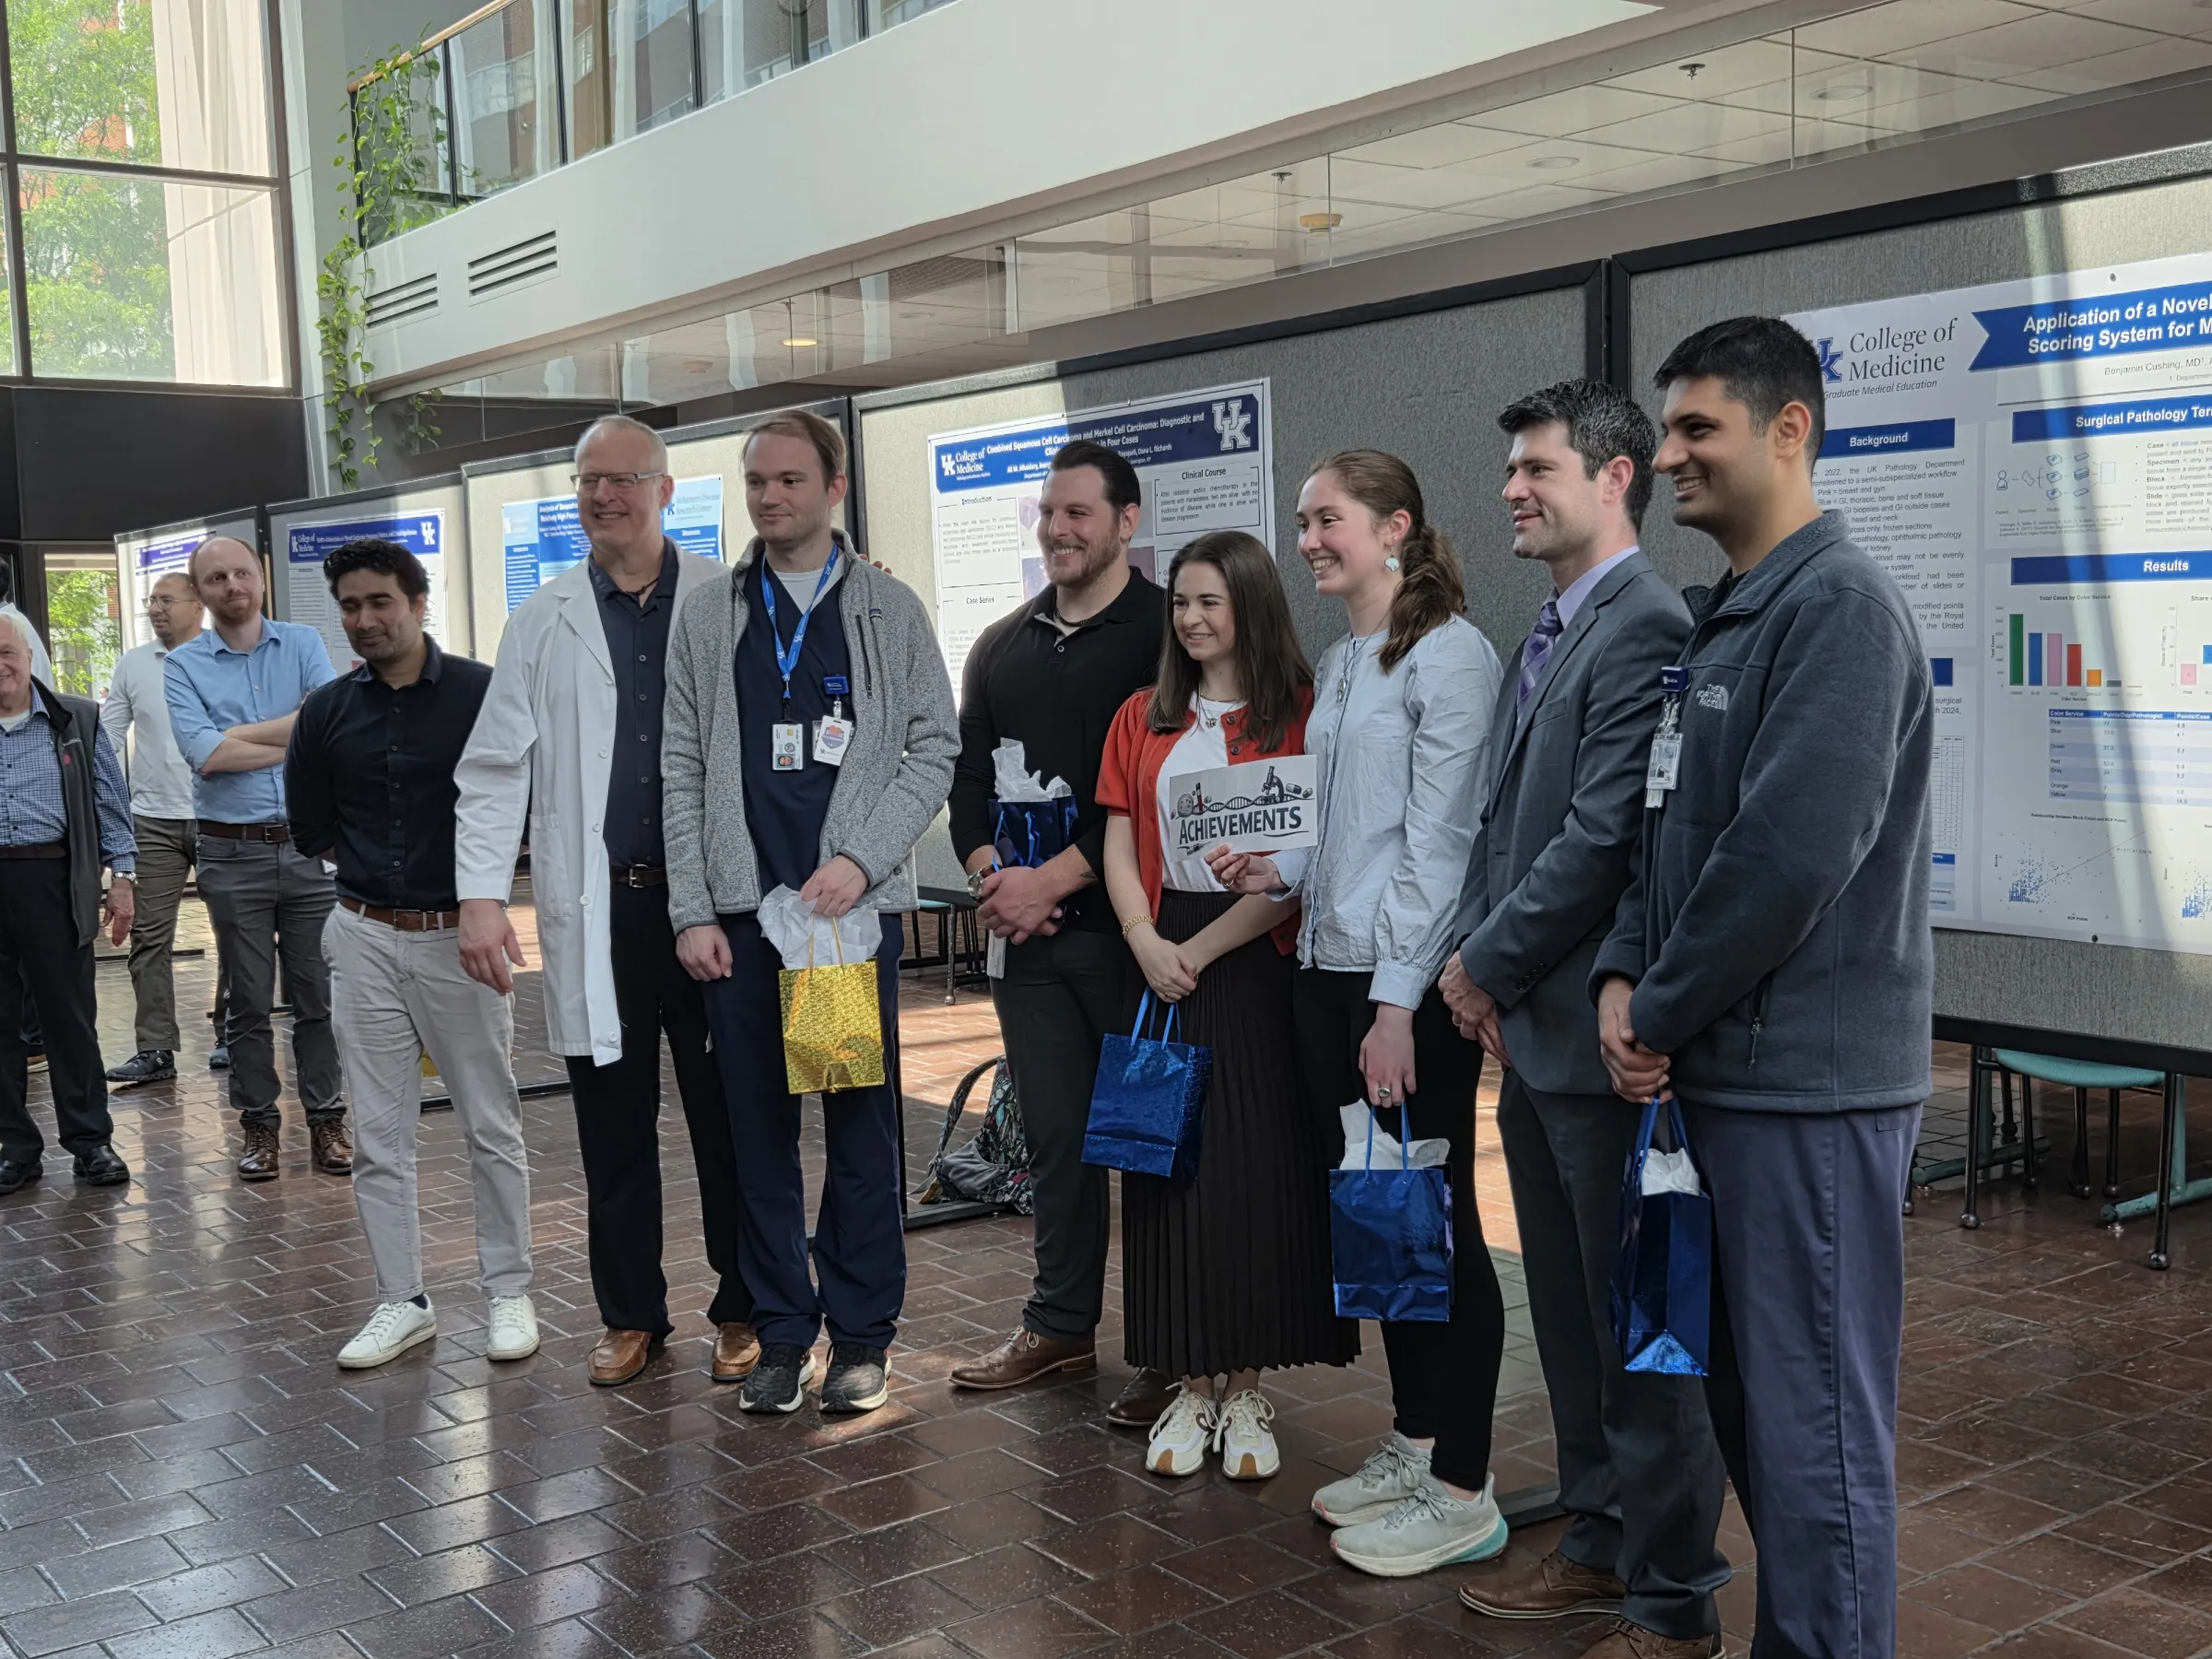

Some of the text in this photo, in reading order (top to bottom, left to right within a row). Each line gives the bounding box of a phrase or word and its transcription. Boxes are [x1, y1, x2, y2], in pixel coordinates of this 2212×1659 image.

[2023, 297, 2212, 334] Application of a Novel
[1850, 318, 1958, 353] College of
[2029, 334, 2093, 354] Scoring
[2099, 327, 2162, 348] System
[2168, 321, 2194, 338] for
[1849, 353, 1945, 381] Medicine
[2105, 364, 2143, 375] Benjamin
[2146, 359, 2183, 373] Cushing,
[1824, 380, 1937, 400] Graduate Medical Education
[1212, 399, 1251, 451] UK
[2076, 413, 2123, 429] Surgical
[2127, 408, 2188, 423] Pathology
[987, 412, 1204, 455] Combined Squamous Cell Carcinoma and Merkel Cell Carcinoma: Diagnostic and
[1850, 432, 1908, 448] Background
[1107, 438, 1120, 447] Four
[1122, 436, 1139, 444] Cases
[1154, 444, 1172, 452] Richards
[956, 448, 985, 463] College of
[941, 453, 955, 476] UK
[956, 462, 983, 475] Medicine
[1885, 463, 1918, 473] Pathology
[1925, 459, 1965, 469] Department
[1182, 467, 1226, 480] Clinical Course
[1813, 477, 1846, 487] ransitioned
[1848, 476, 1854, 484] to
[1862, 472, 1926, 483] semi-subspecialized
[1928, 470, 1957, 478] workflow
[1210, 484, 1239, 492] chemotherapy
[1839, 487, 1858, 495] breast
[962, 496, 992, 506] Introduction
[1853, 506, 1879, 514] biopsies
[298, 535, 311, 543] College
[1891, 531, 1962, 541] ophthalmic pathology
[299, 544, 314, 552] Medicine
[2143, 560, 2189, 573] Results
[1697, 690, 1718, 700] NORTH
[1935, 697, 1962, 705] surgical
[1699, 699, 1717, 708] FACE
[1942, 707, 1961, 715] 2024,
[1179, 806, 1302, 845] ACHIEVEMENTS
